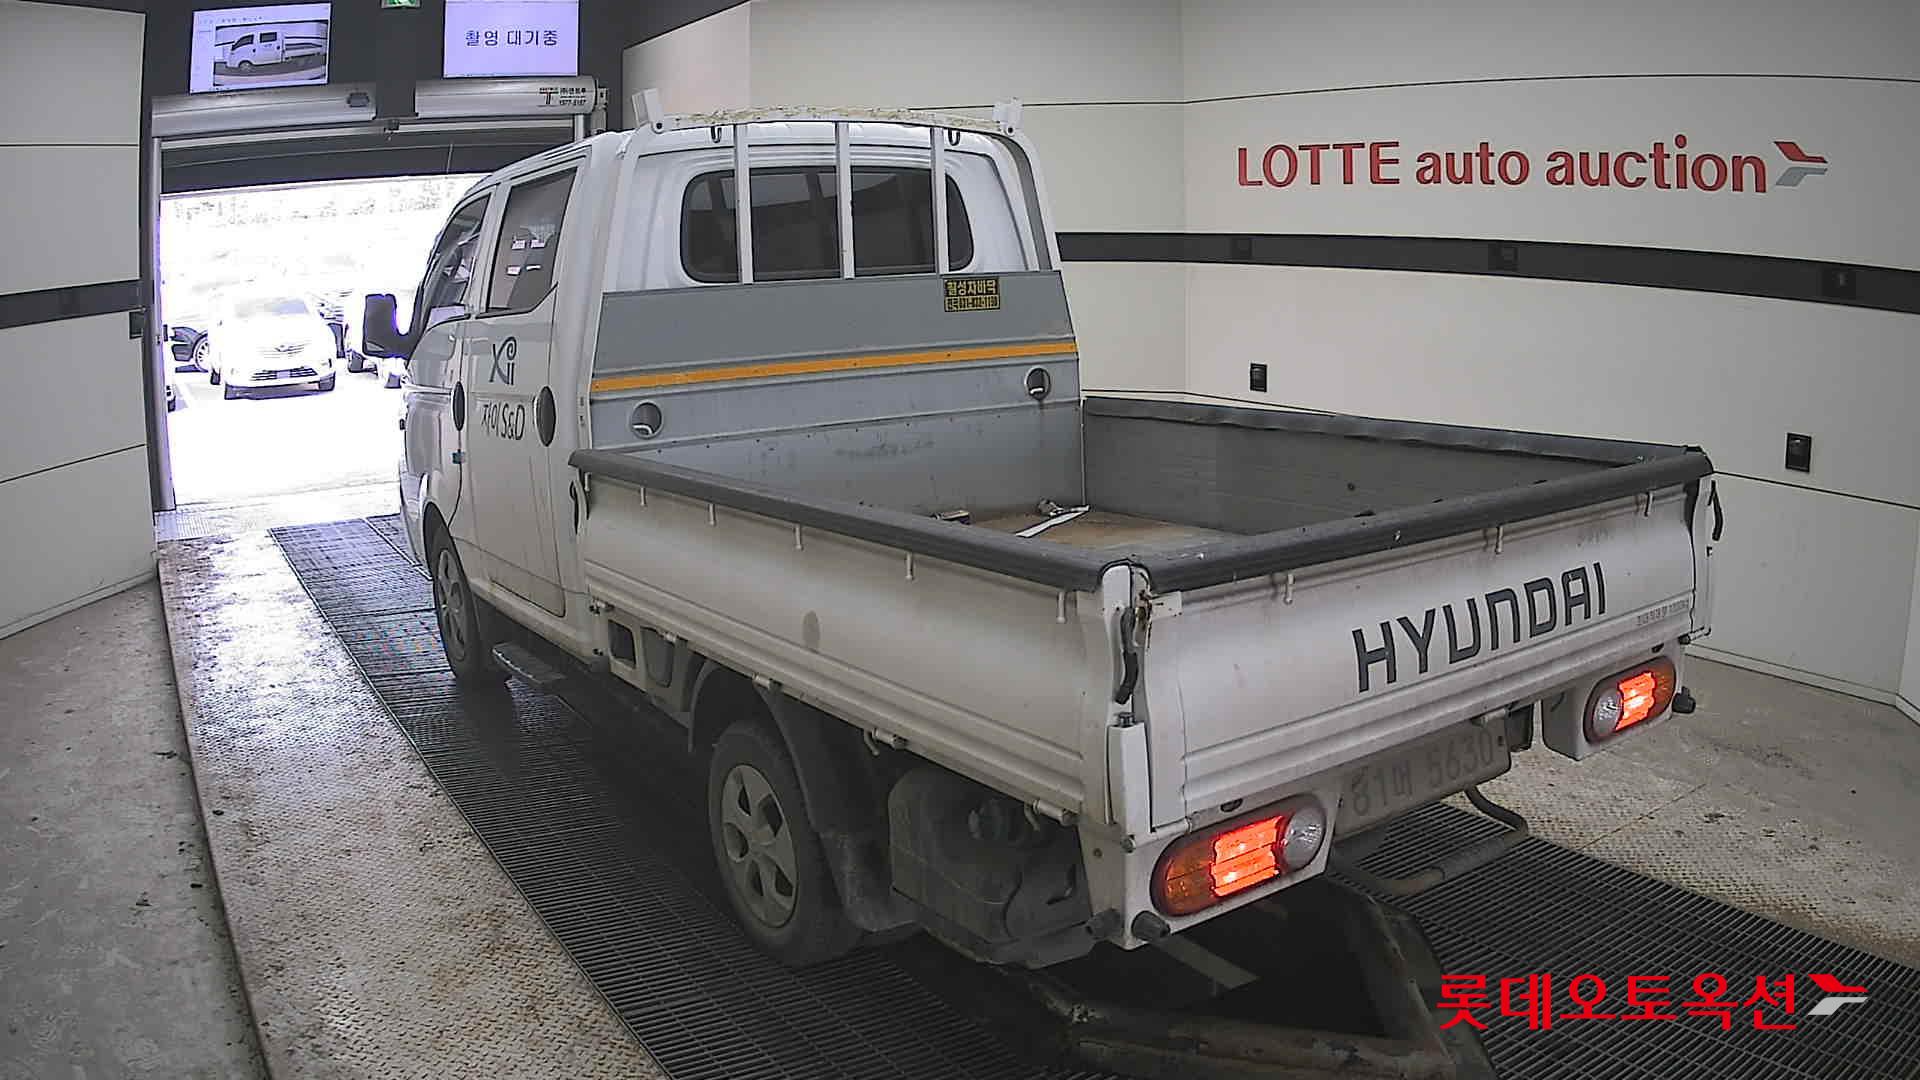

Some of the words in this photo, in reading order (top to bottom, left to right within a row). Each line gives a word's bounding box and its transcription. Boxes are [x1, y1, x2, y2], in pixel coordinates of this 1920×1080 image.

[465, 30, 499, 47] 촬영
[506, 29, 558, 46] 대기중
[1237, 140, 1400, 188] LOTTE
[1415, 140, 1530, 187] auto
[1545, 134, 1767, 194] auction
[1351, 561, 1607, 694] HYUNDAI
